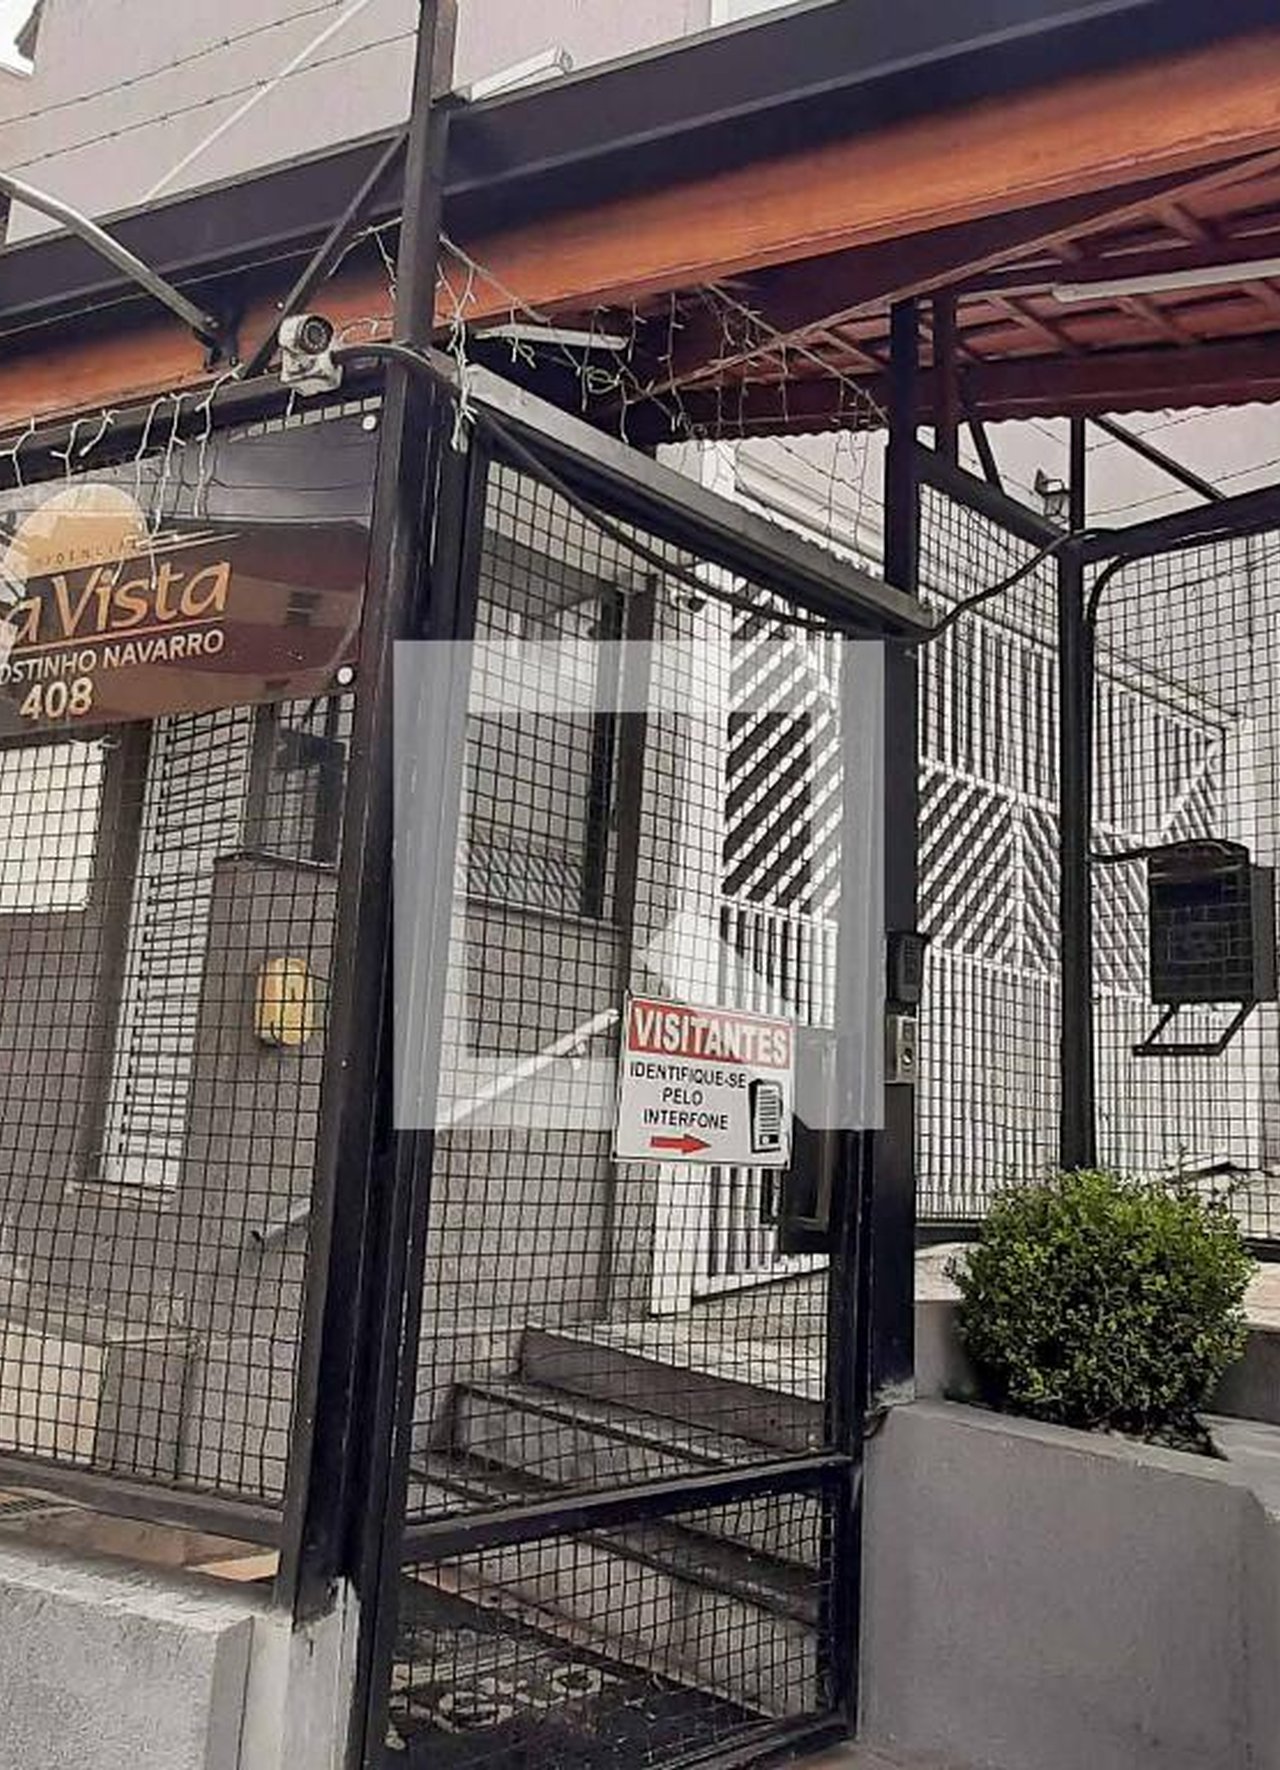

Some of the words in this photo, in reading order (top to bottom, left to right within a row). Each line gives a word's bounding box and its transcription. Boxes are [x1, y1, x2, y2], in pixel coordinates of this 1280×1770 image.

[103, 629, 224, 669] NAVARRO
[20, 676, 93, 719] 408
[633, 1006, 787, 1065] VISITANTES
[630, 1061, 747, 1089] IDENTIFIQUE-SE
[662, 1086, 703, 1106] PELO
[644, 1108, 728, 1130] INTERFONE
